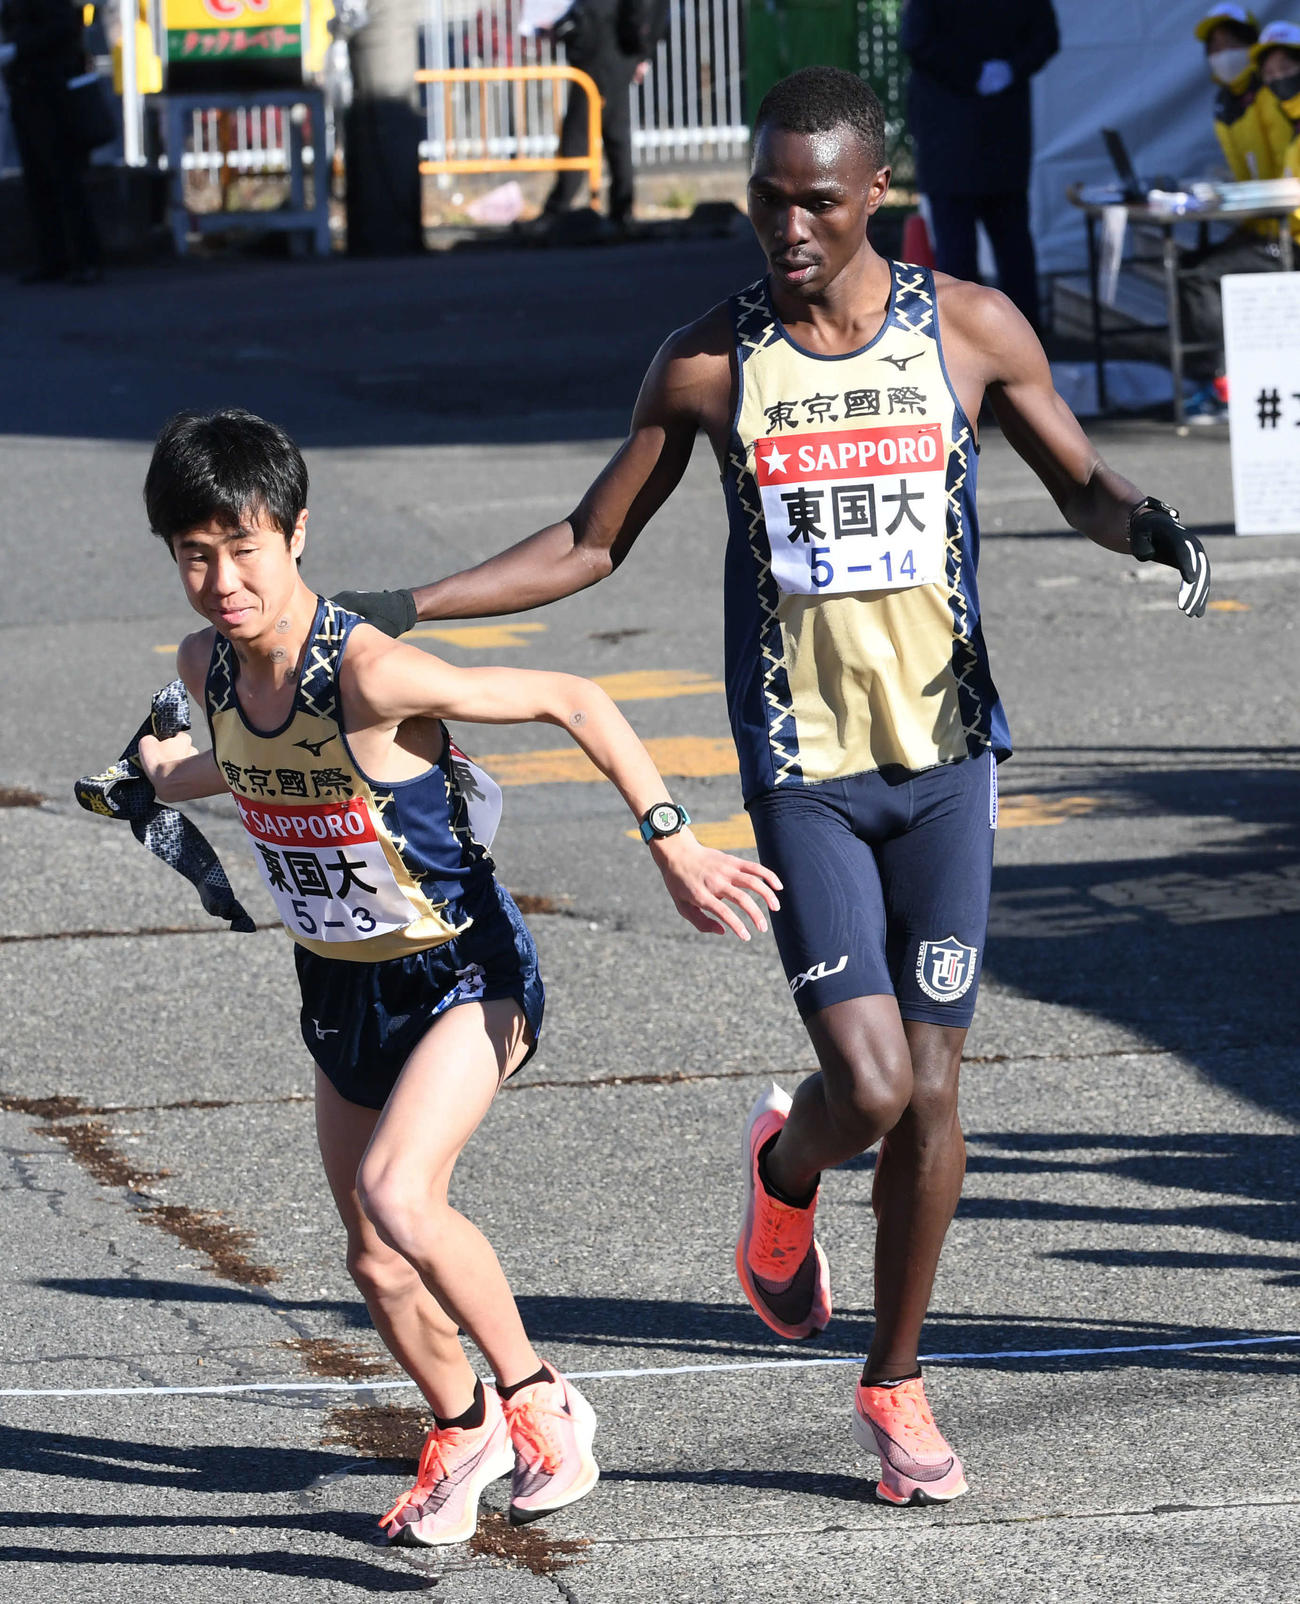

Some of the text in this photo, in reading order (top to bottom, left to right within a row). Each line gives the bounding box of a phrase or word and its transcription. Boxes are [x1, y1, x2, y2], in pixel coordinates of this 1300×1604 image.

[763, 386, 928, 434] 東京國際
[798, 435, 936, 473] SAPPORO
[780, 478, 927, 544] 東国大
[222, 760, 354, 798] 東京國際
[250, 811, 365, 839] SAPPORO
[254, 841, 378, 900] 東国大
